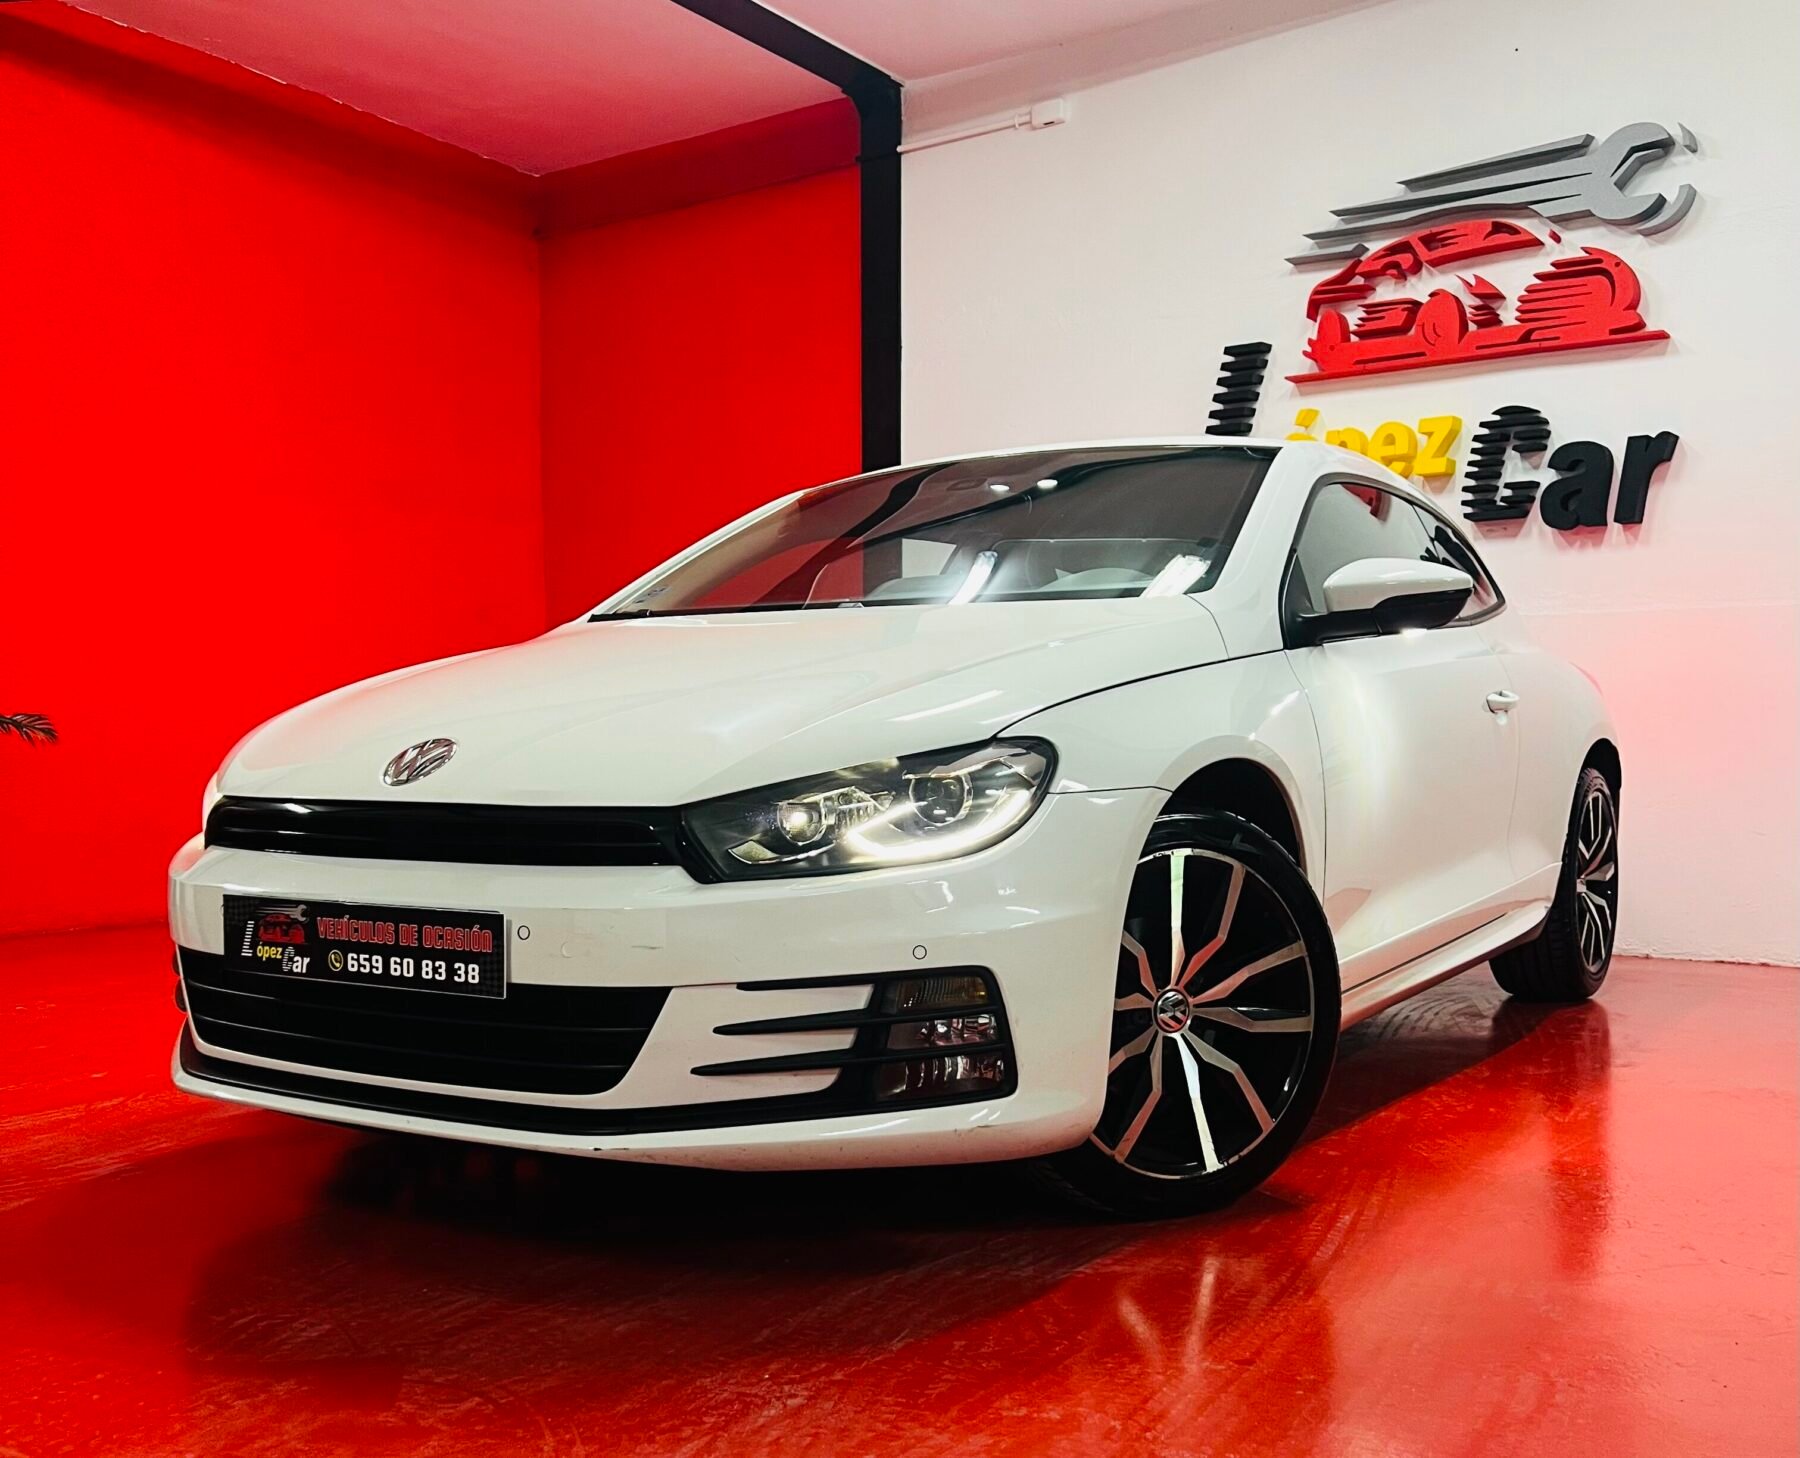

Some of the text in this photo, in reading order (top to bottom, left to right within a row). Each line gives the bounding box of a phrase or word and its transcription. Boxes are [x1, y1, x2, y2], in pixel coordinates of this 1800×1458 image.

[1205, 341, 1680, 531] Lez Car
[241, 921, 311, 974] López Car
[316, 914, 493, 953] VEHÍCULOS DE OCASIÓN
[347, 952, 480, 984] 659 60 83 38
